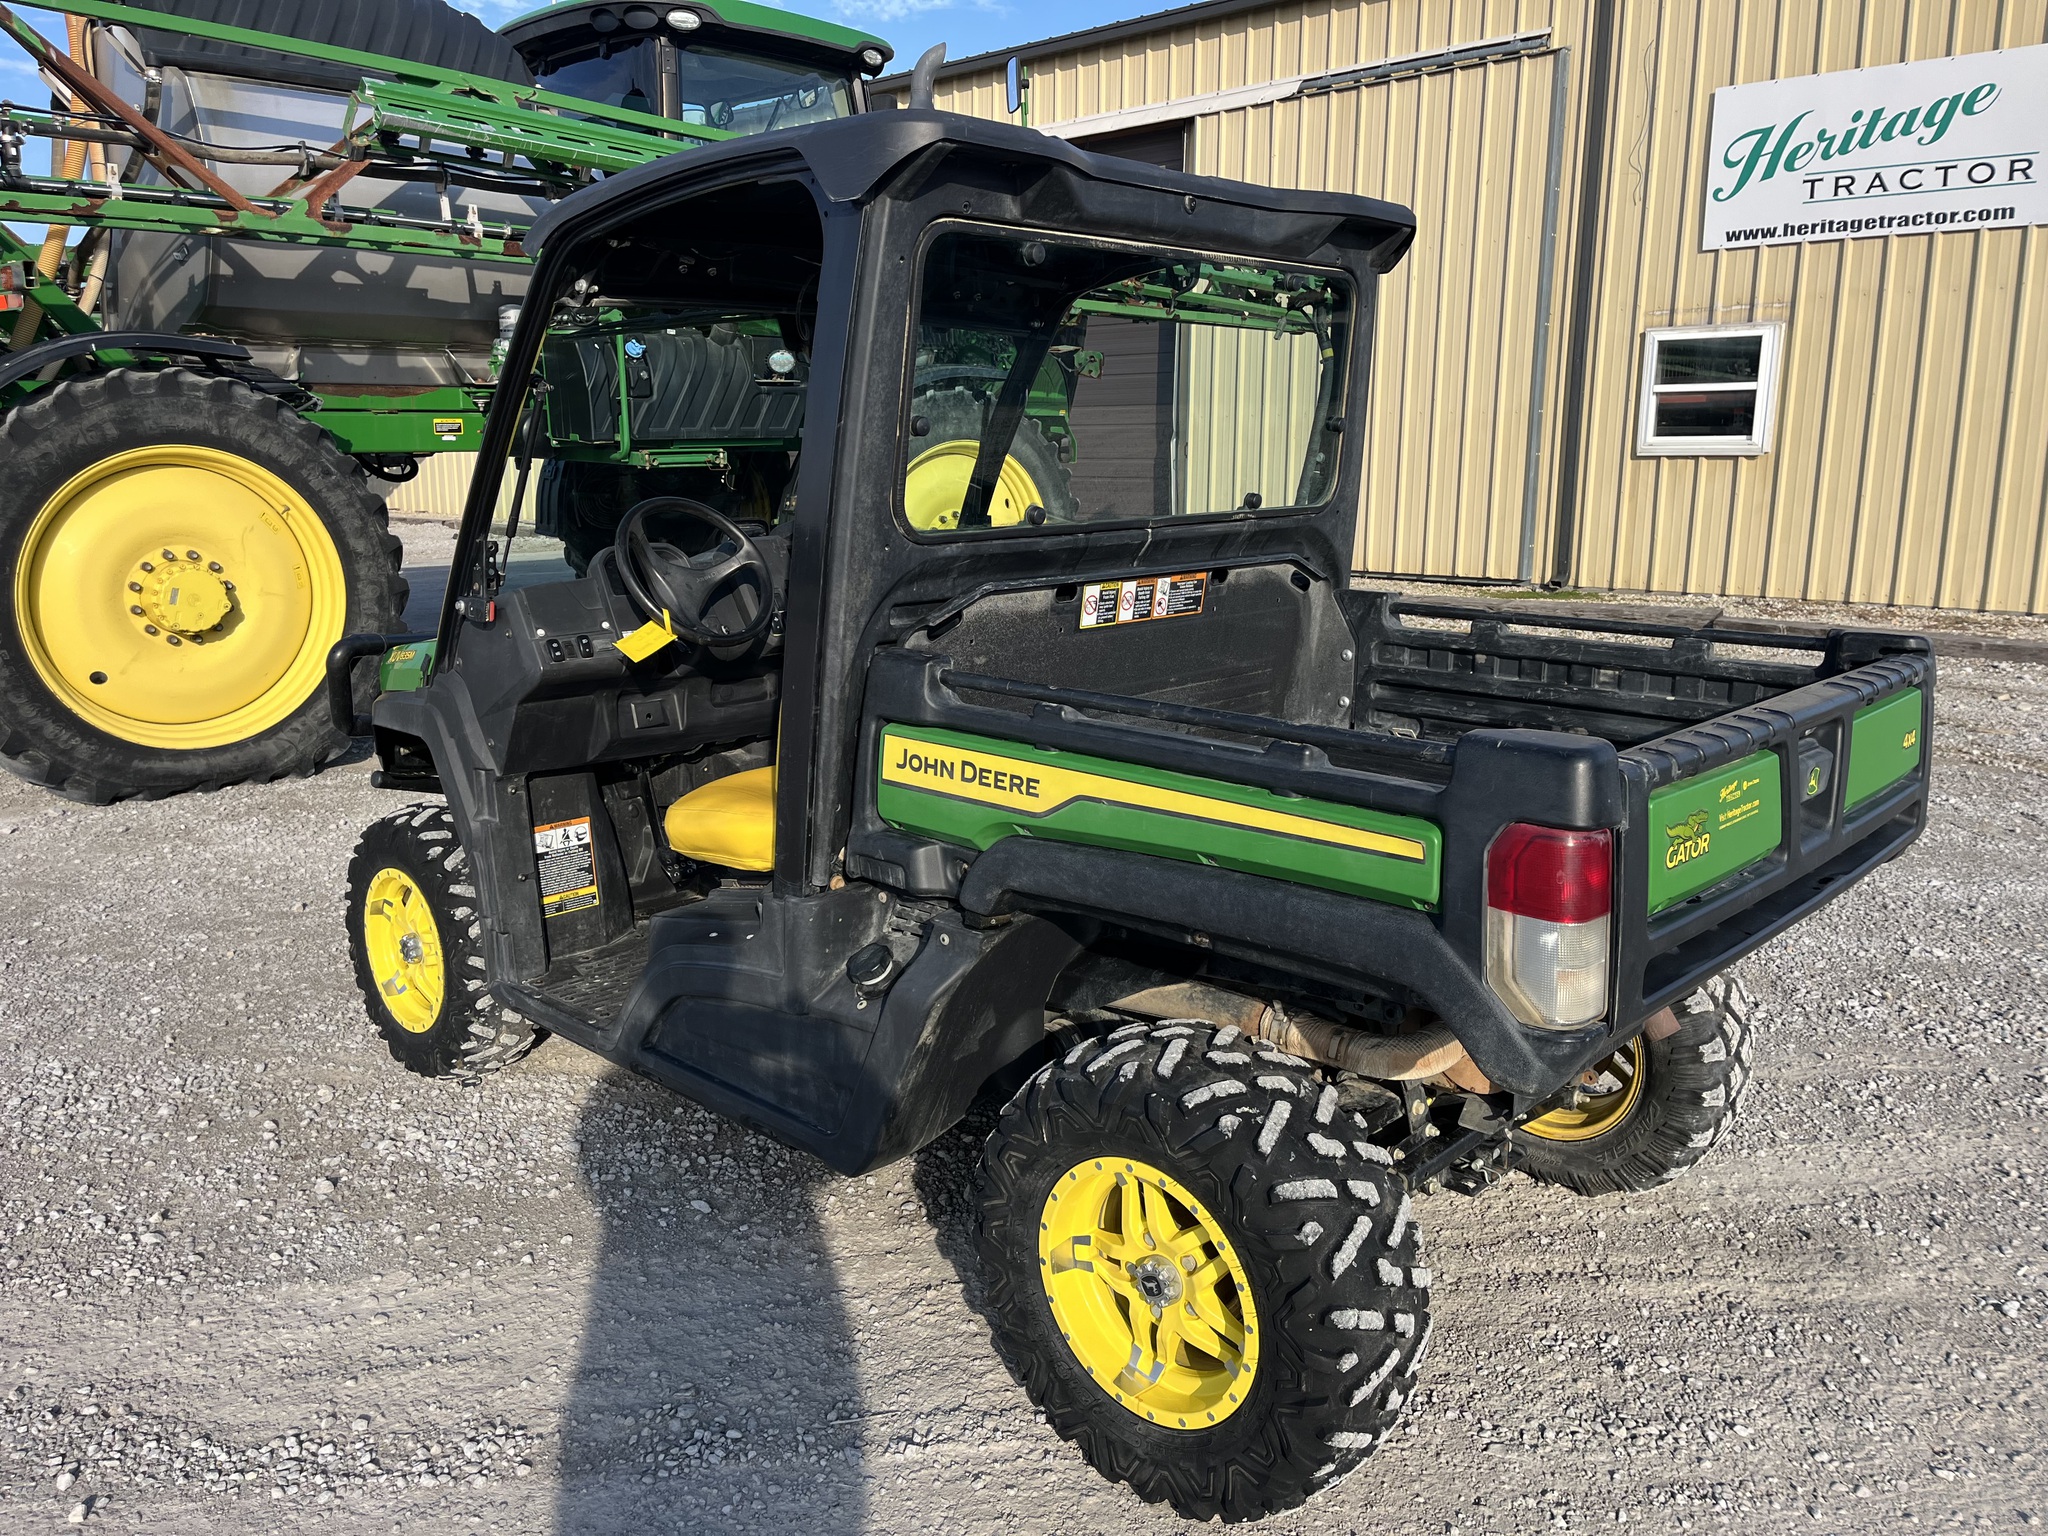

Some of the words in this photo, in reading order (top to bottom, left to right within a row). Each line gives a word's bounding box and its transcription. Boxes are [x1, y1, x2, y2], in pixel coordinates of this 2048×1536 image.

[1712, 82, 2002, 202] Heritage
[1802, 158, 2034, 200] TRACTOR
[1726, 206, 2016, 243] www.heritagetractor.com
[896, 748, 954, 780] JOHN
[960, 760, 1040, 798] DEERE
[1666, 833, 1710, 869] GATOR
